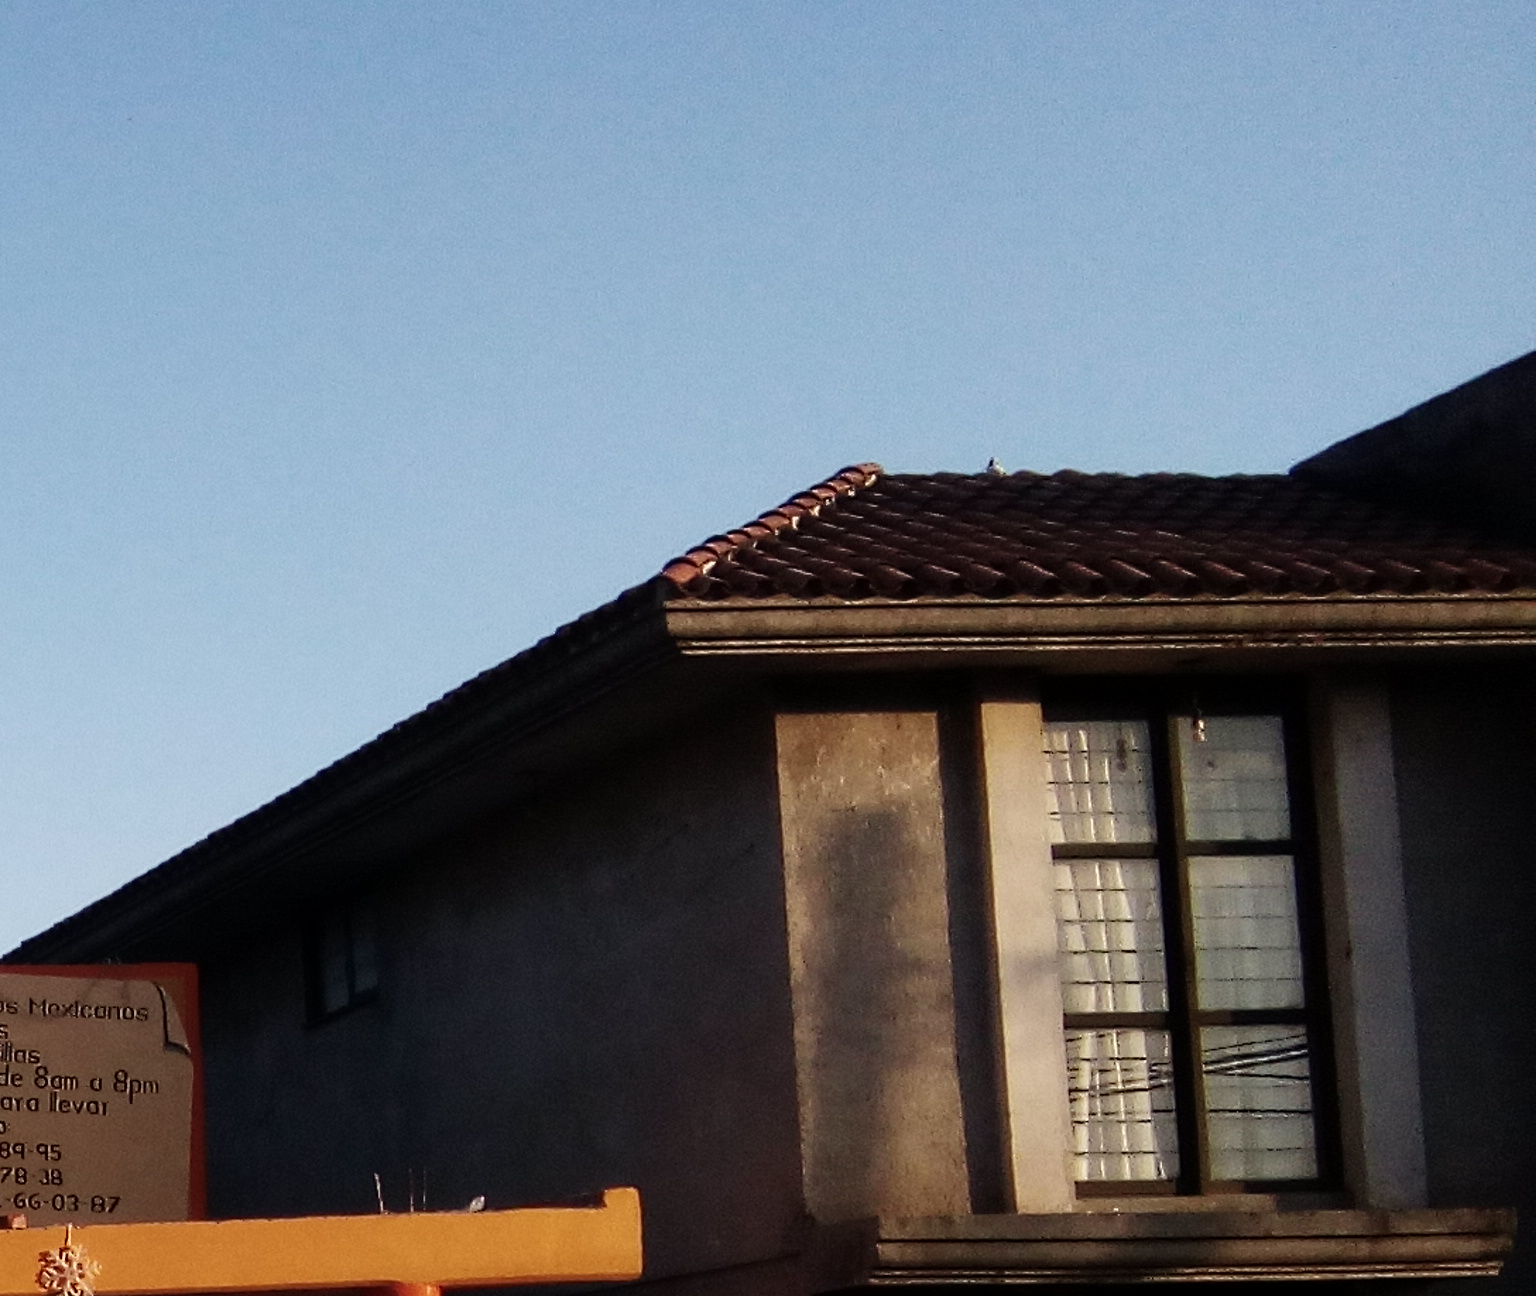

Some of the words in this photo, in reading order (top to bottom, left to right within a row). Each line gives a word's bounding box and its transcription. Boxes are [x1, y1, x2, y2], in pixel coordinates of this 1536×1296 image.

[30, 998, 149, 1023] Mexicanos
[34, 1066, 79, 1091] 8am
[89, 1077, 103, 1092] a
[113, 1069, 159, 1104] 8pm
[49, 1091, 108, 1116] llevar
